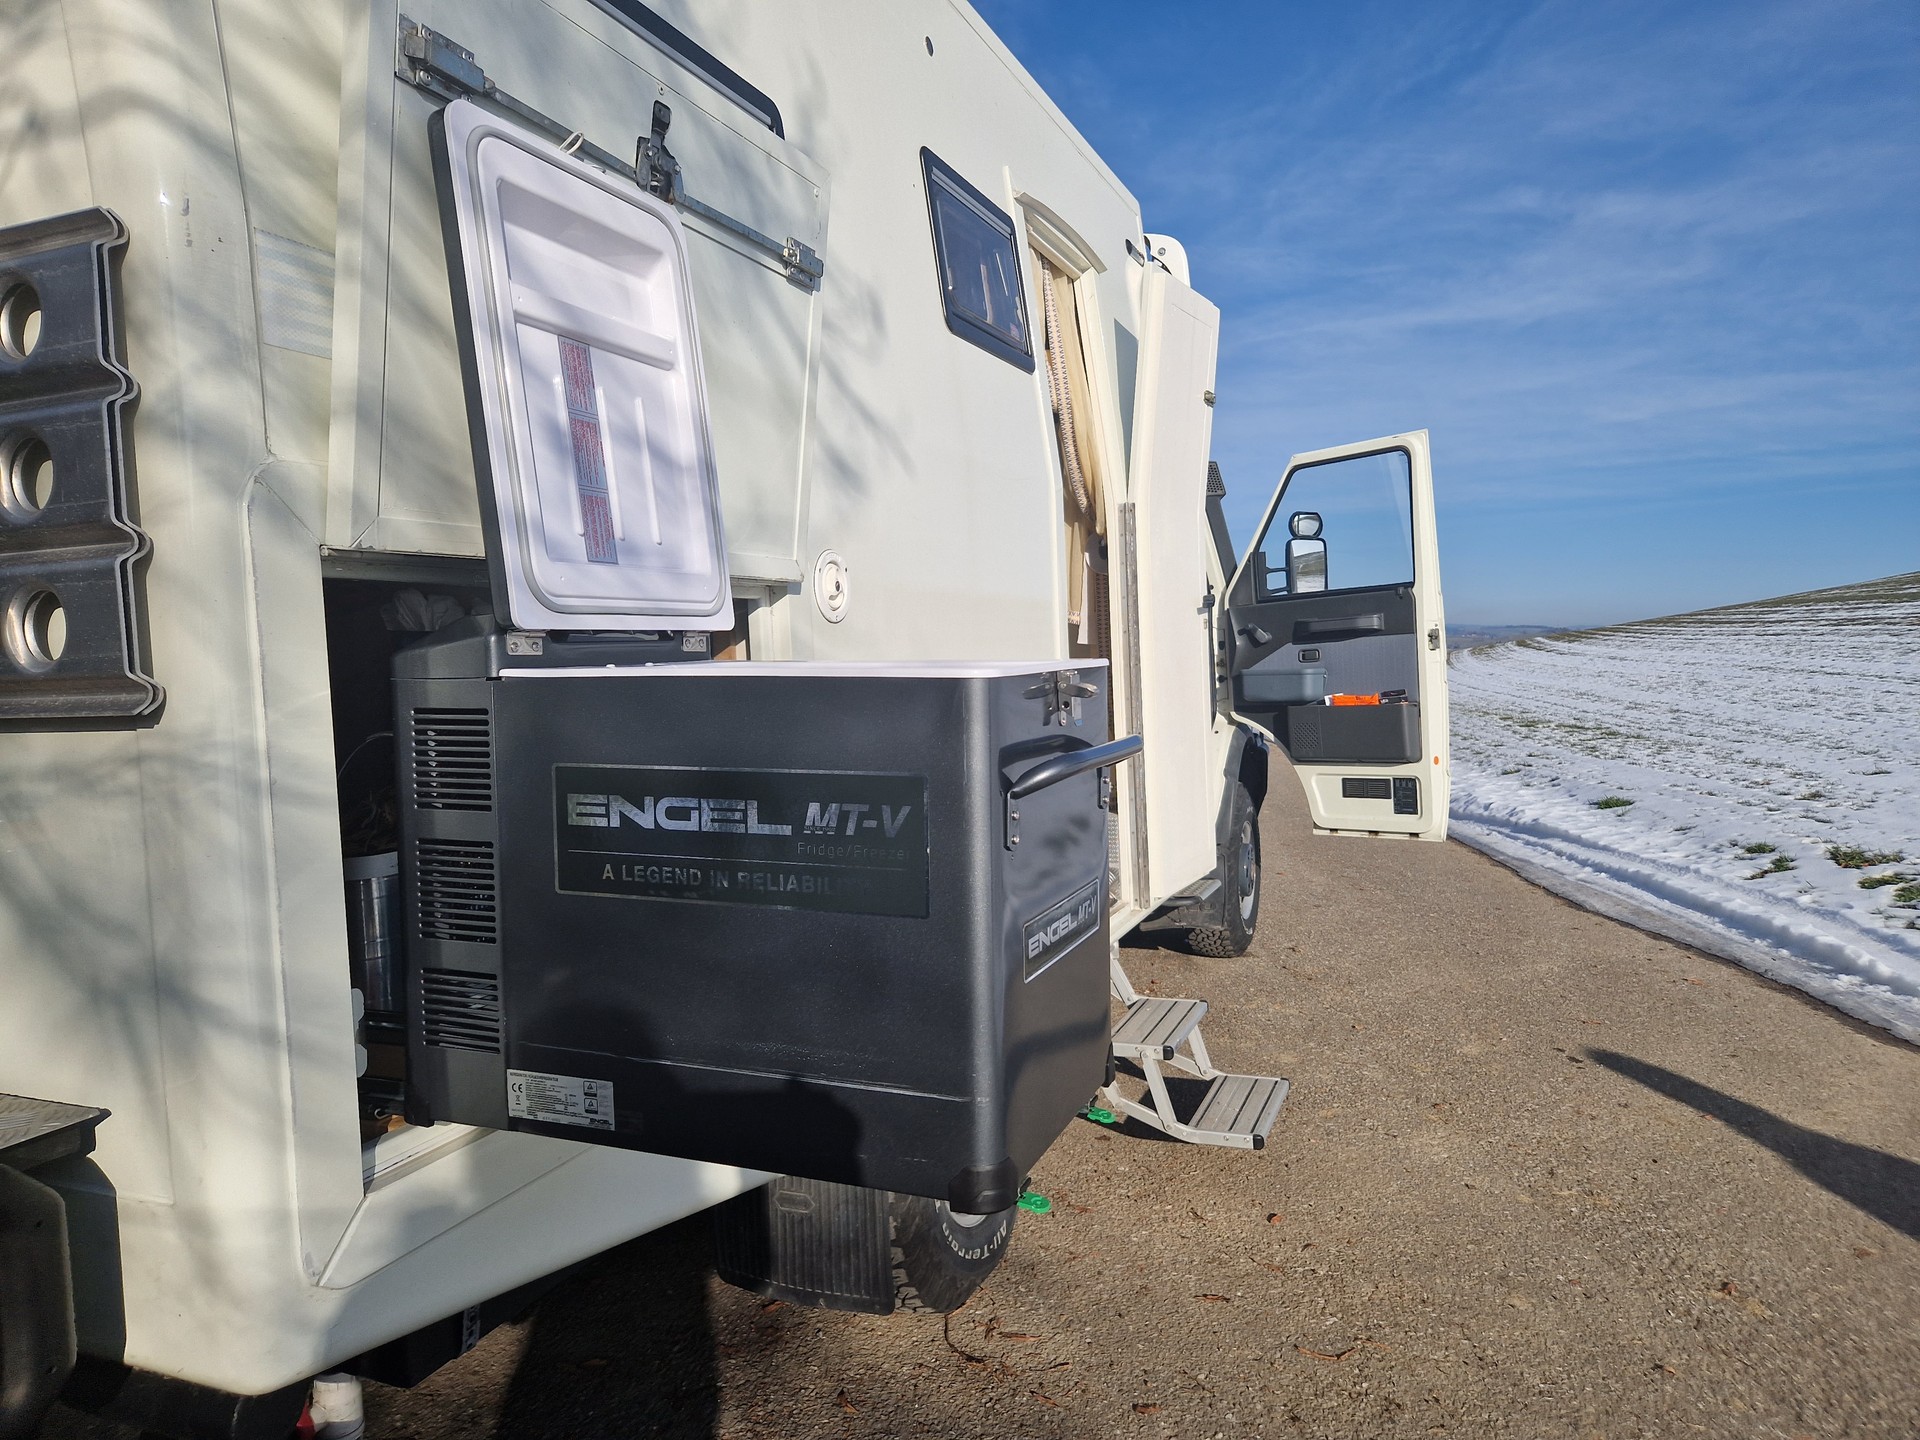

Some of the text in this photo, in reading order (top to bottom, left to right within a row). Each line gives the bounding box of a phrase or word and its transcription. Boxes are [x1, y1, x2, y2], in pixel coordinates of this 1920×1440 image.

[567, 793, 912, 838] ENGEL MT-V
[797, 842, 910, 860] Fridge/Freezer
[602, 864, 615, 880] A
[622, 864, 702, 886] LEGEND
[710, 869, 729, 888] IN
[1028, 912, 1078, 959] ENGEL
